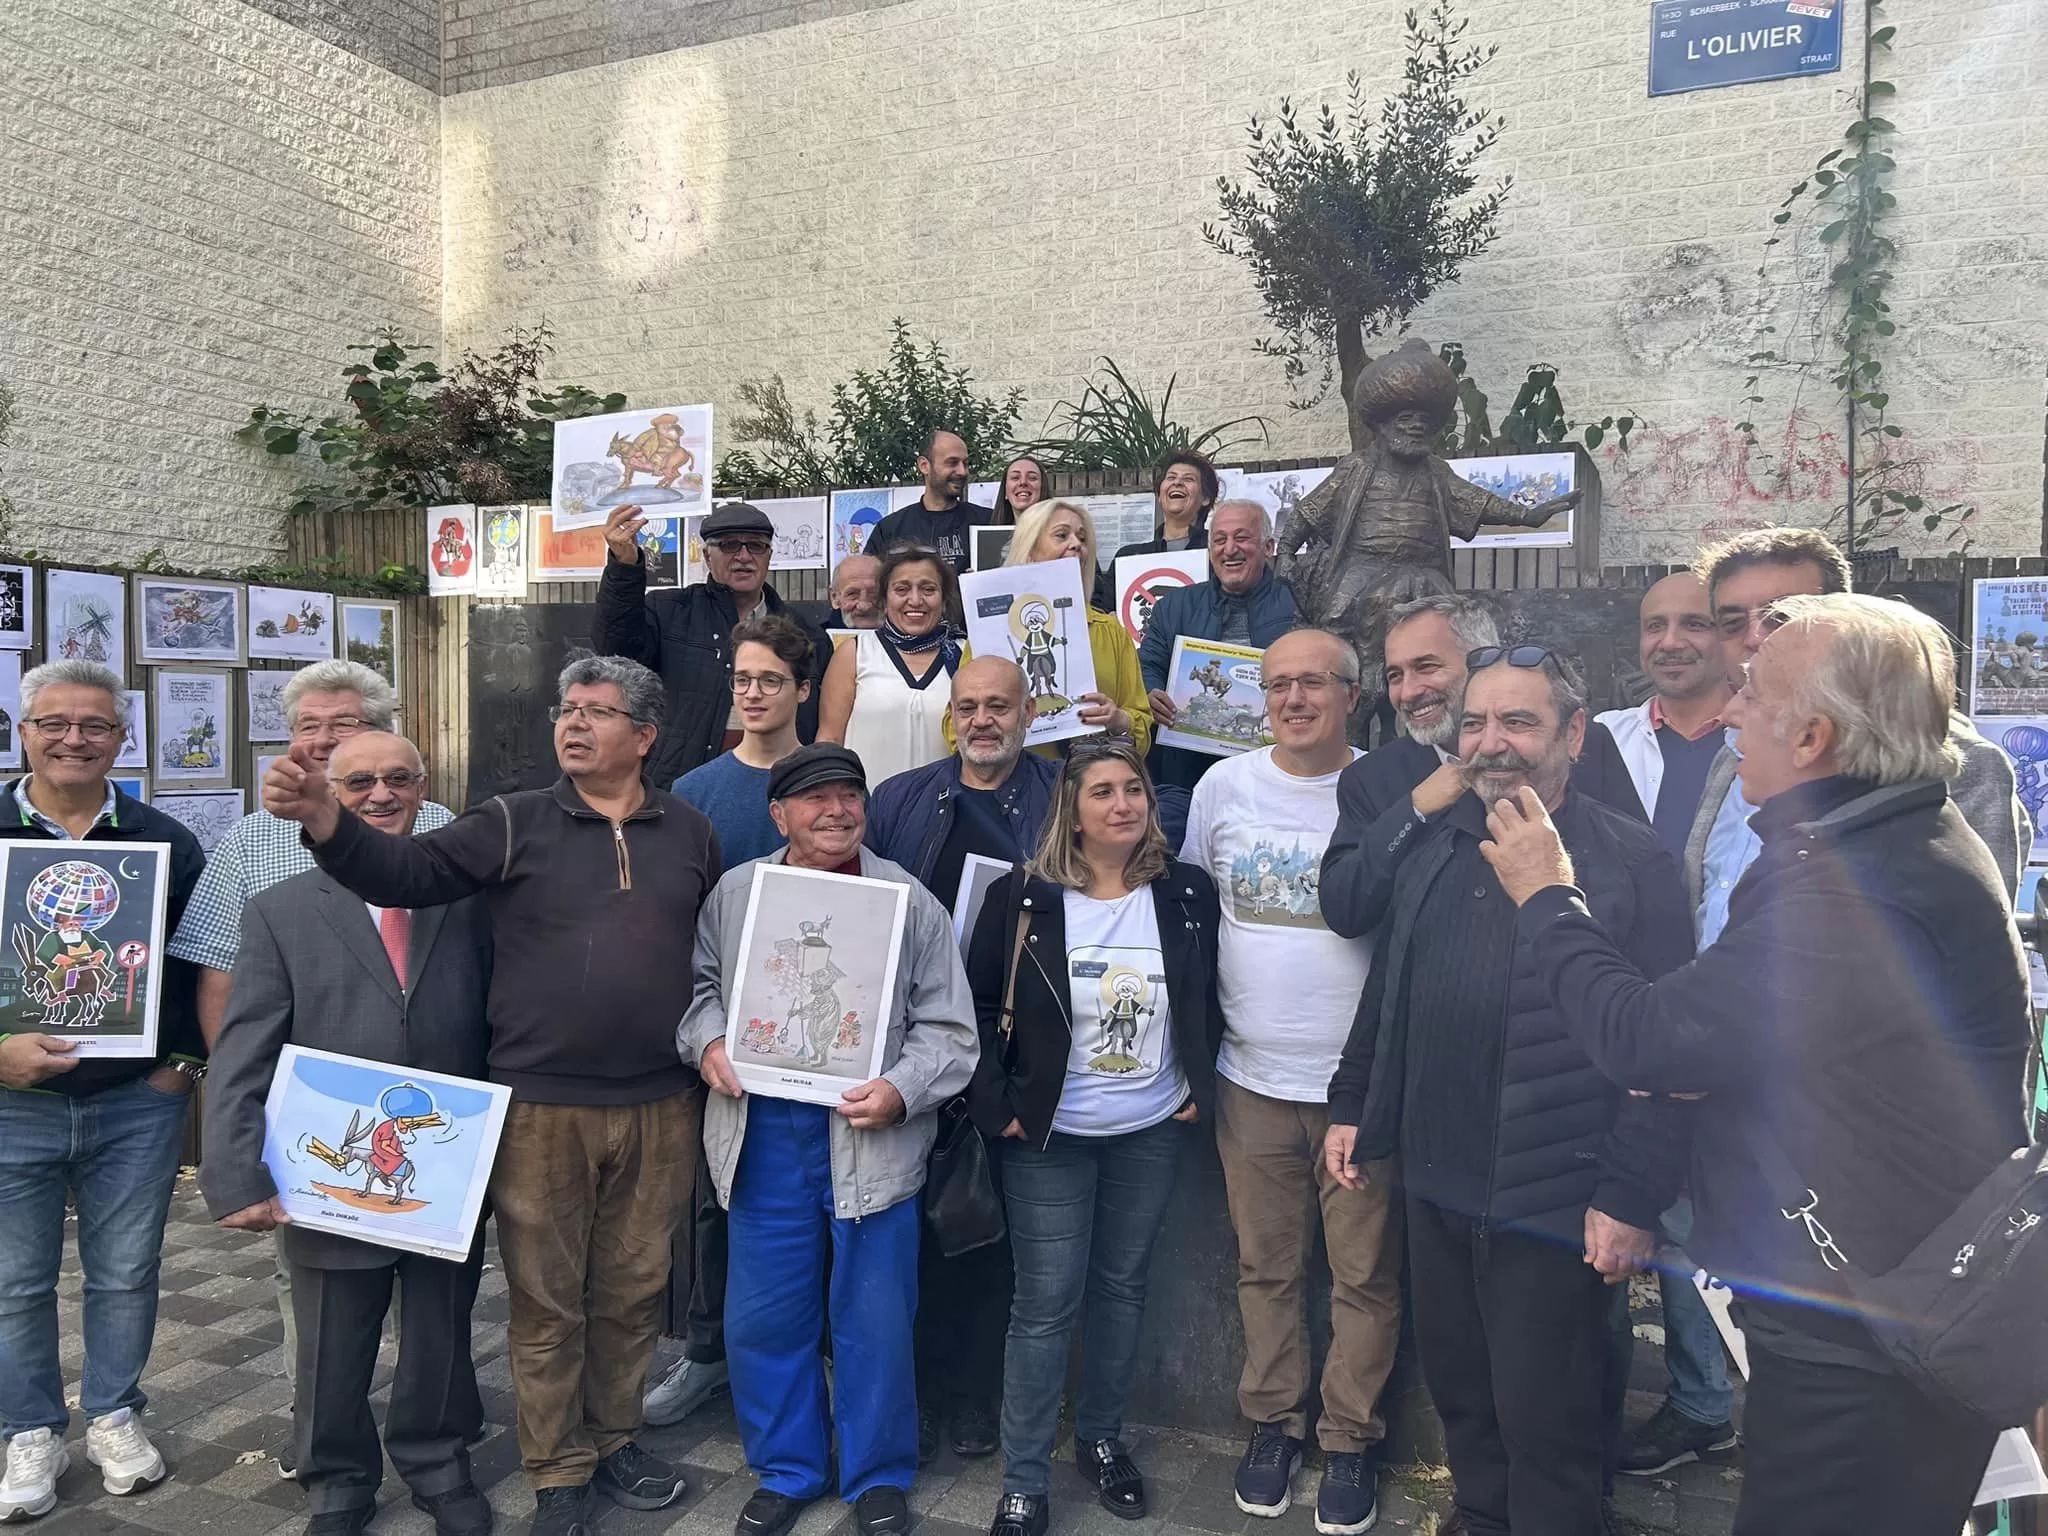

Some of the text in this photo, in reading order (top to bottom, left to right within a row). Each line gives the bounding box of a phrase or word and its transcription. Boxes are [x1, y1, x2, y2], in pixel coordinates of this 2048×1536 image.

[1690, 2, 1740, 17] SCHAERBEEK
[1660, 30, 1678, 39] RUE
[1687, 25, 1803, 60] L'OLIVIER
[1800, 53, 1832, 65] STRAAT
